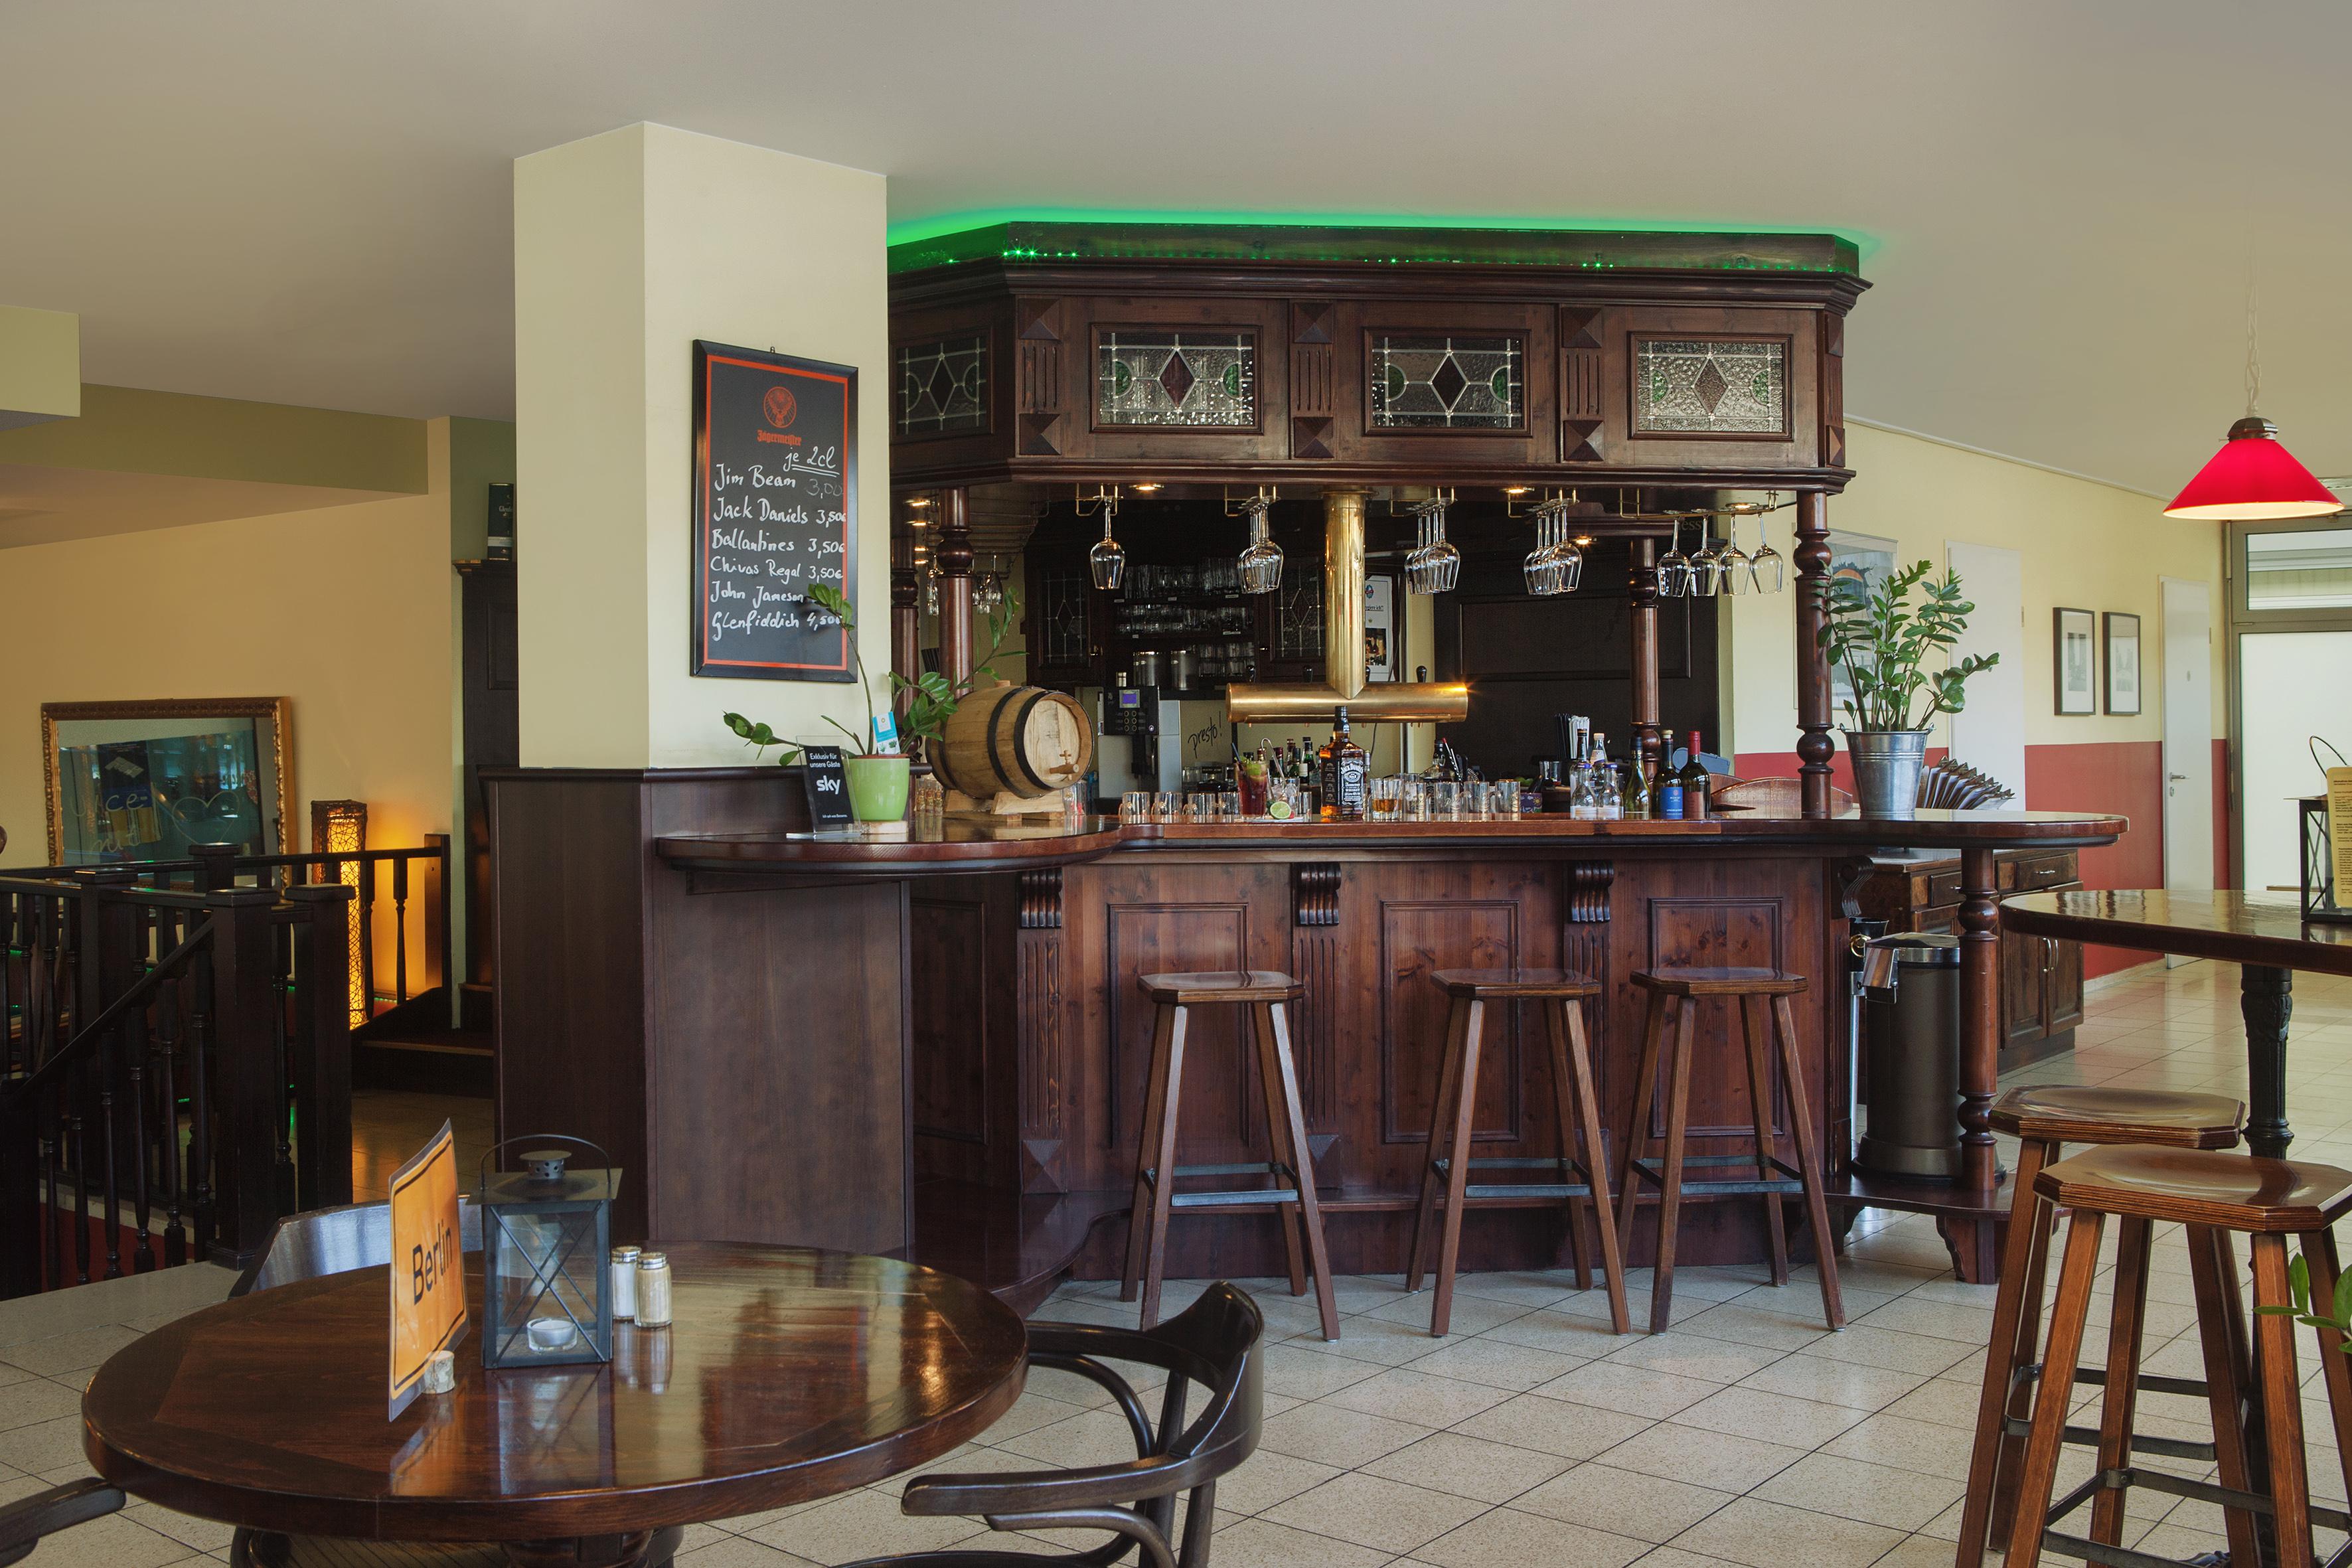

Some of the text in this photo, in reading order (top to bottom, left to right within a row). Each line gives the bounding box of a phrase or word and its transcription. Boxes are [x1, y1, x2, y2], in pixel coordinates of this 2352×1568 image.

[783, 446, 836, 472] je 2cl
[714, 463, 744, 491] Jim
[748, 465, 796, 488] Beam
[713, 495, 753, 521] Jack
[757, 498, 808, 524] Daniels
[712, 528, 795, 552] Ballantines
[710, 556, 843, 585] Chivas Regal 3,50€
[710, 580, 804, 609] John Jameson
[1188, 711, 1222, 759] presto!
[817, 775, 840, 795] sky
[413, 1218, 453, 1306] Berlin
